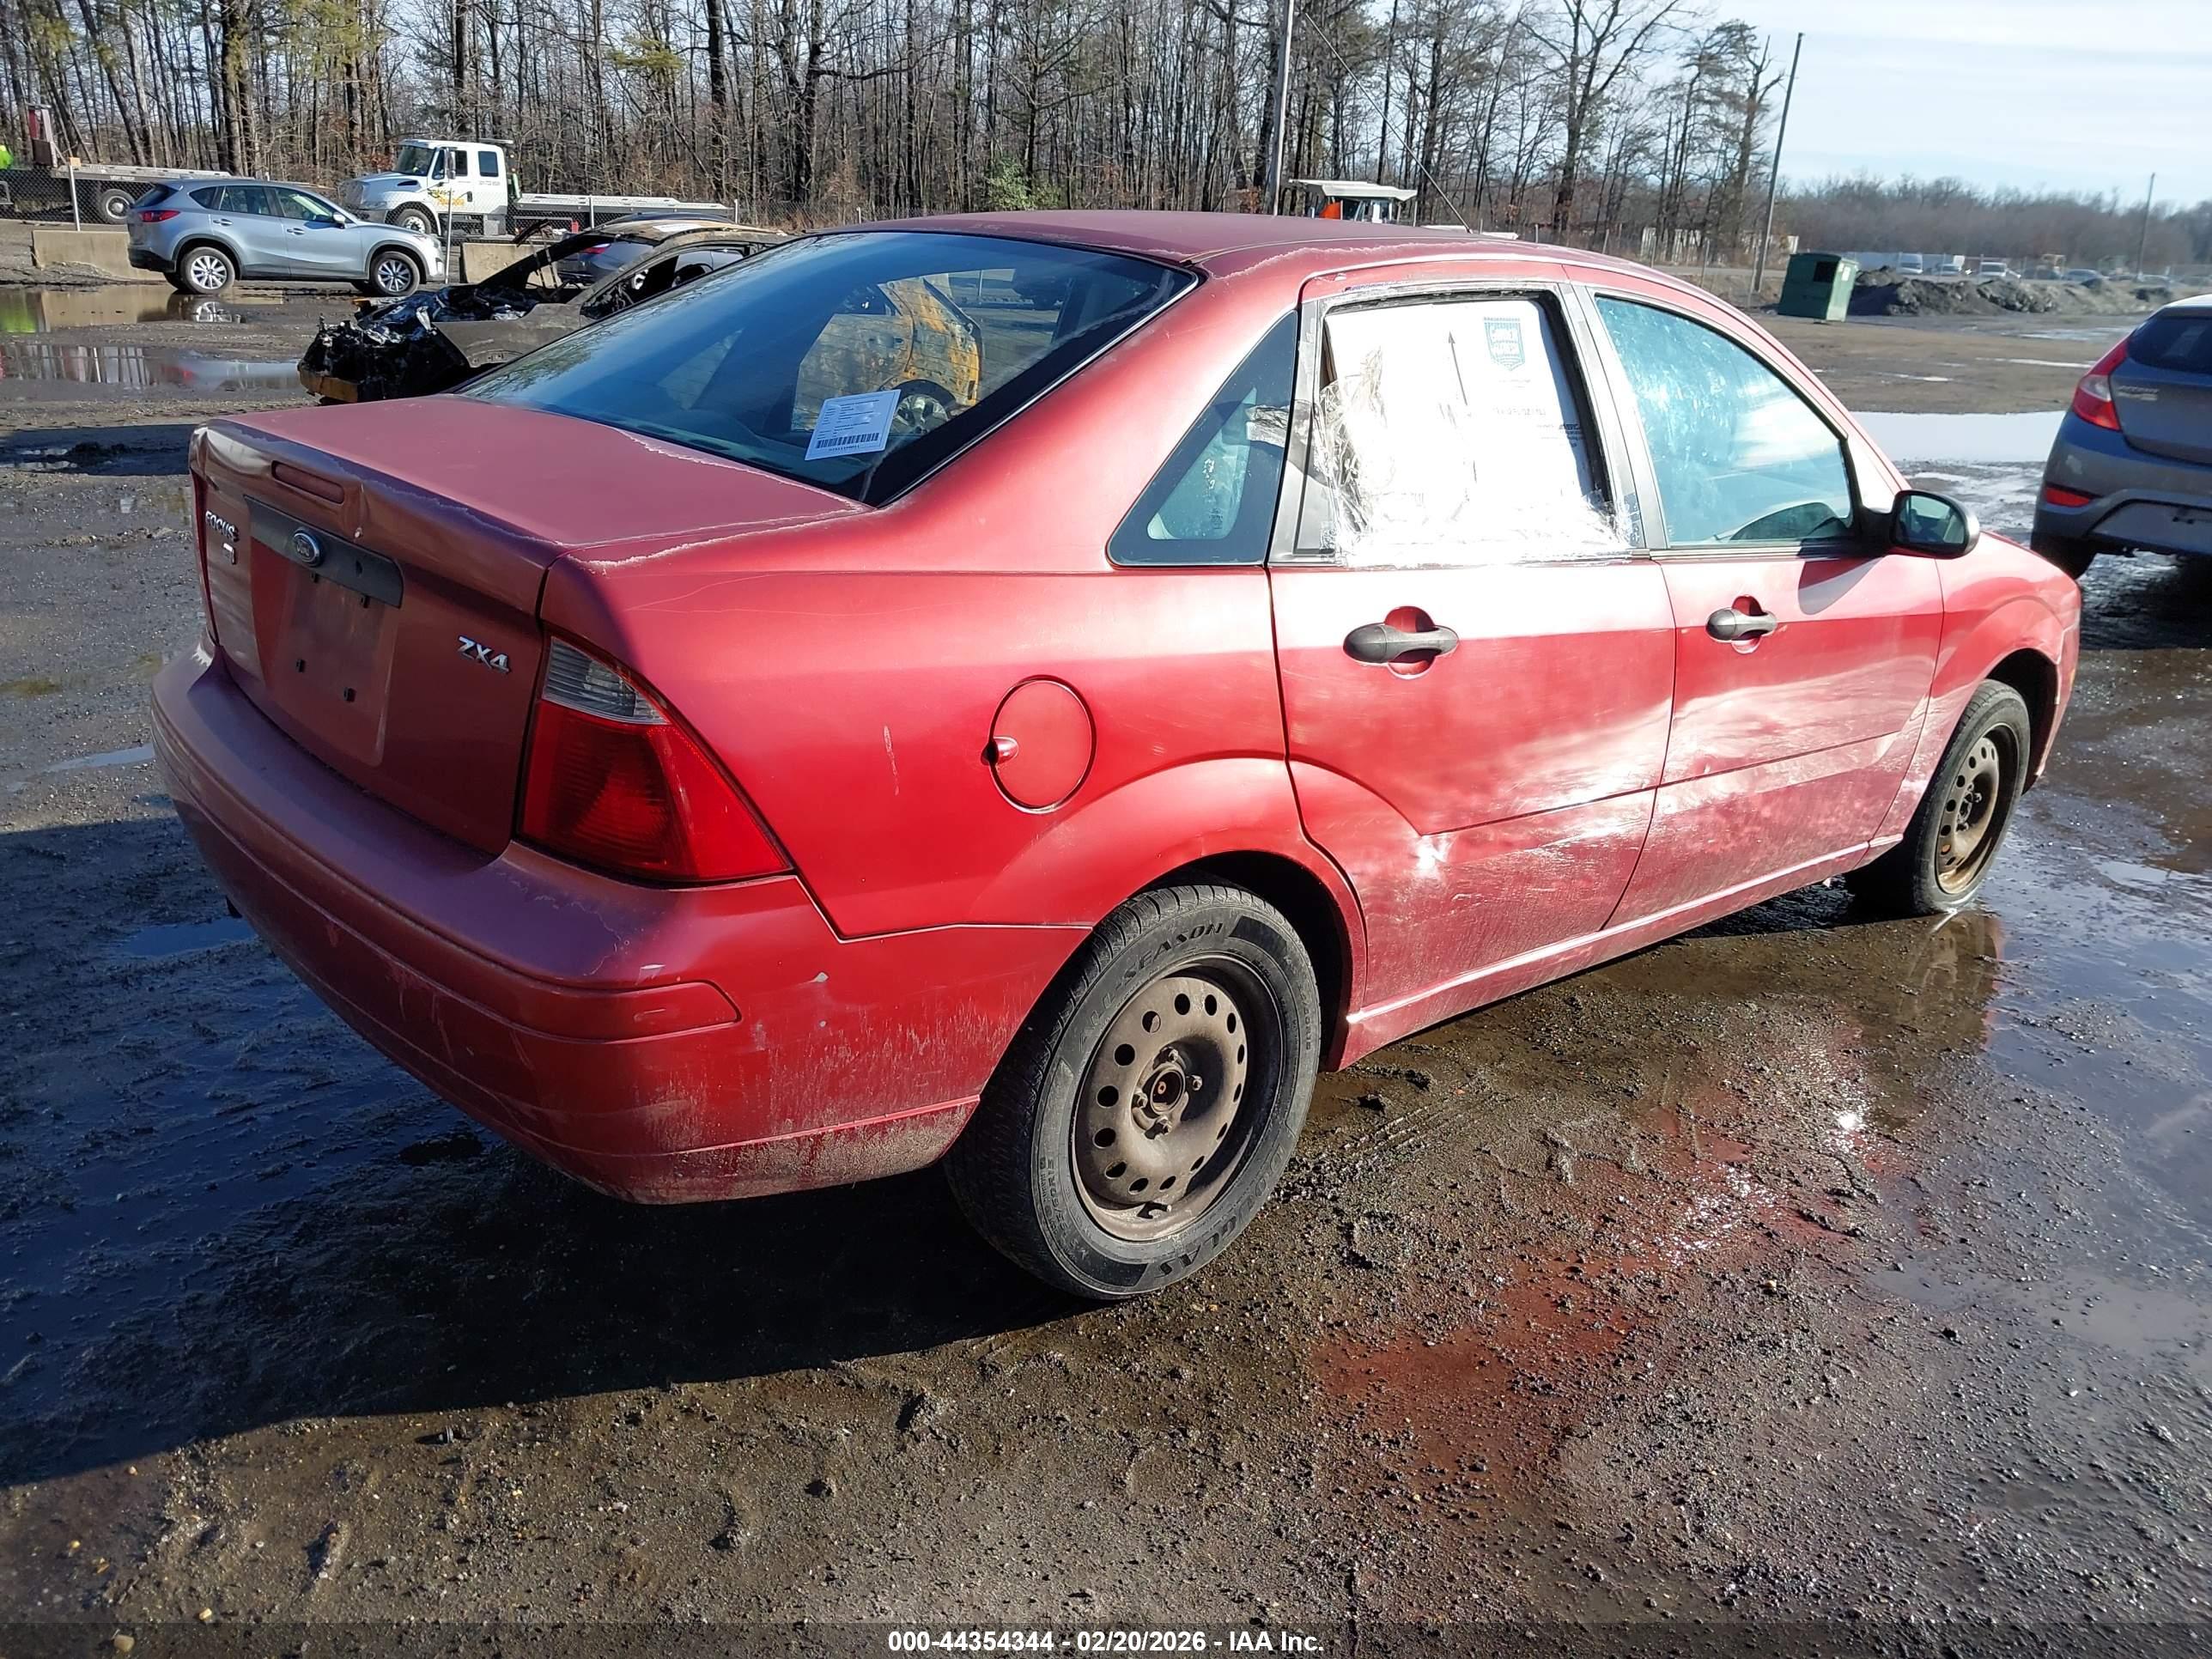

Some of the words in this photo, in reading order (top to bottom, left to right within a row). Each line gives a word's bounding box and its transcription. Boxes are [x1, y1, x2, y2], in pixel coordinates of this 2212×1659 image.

[205, 510, 237, 540] FOCUS
[457, 636, 510, 672] ZX4
[1152, 1142, 1286, 1279] DOUGLAS
